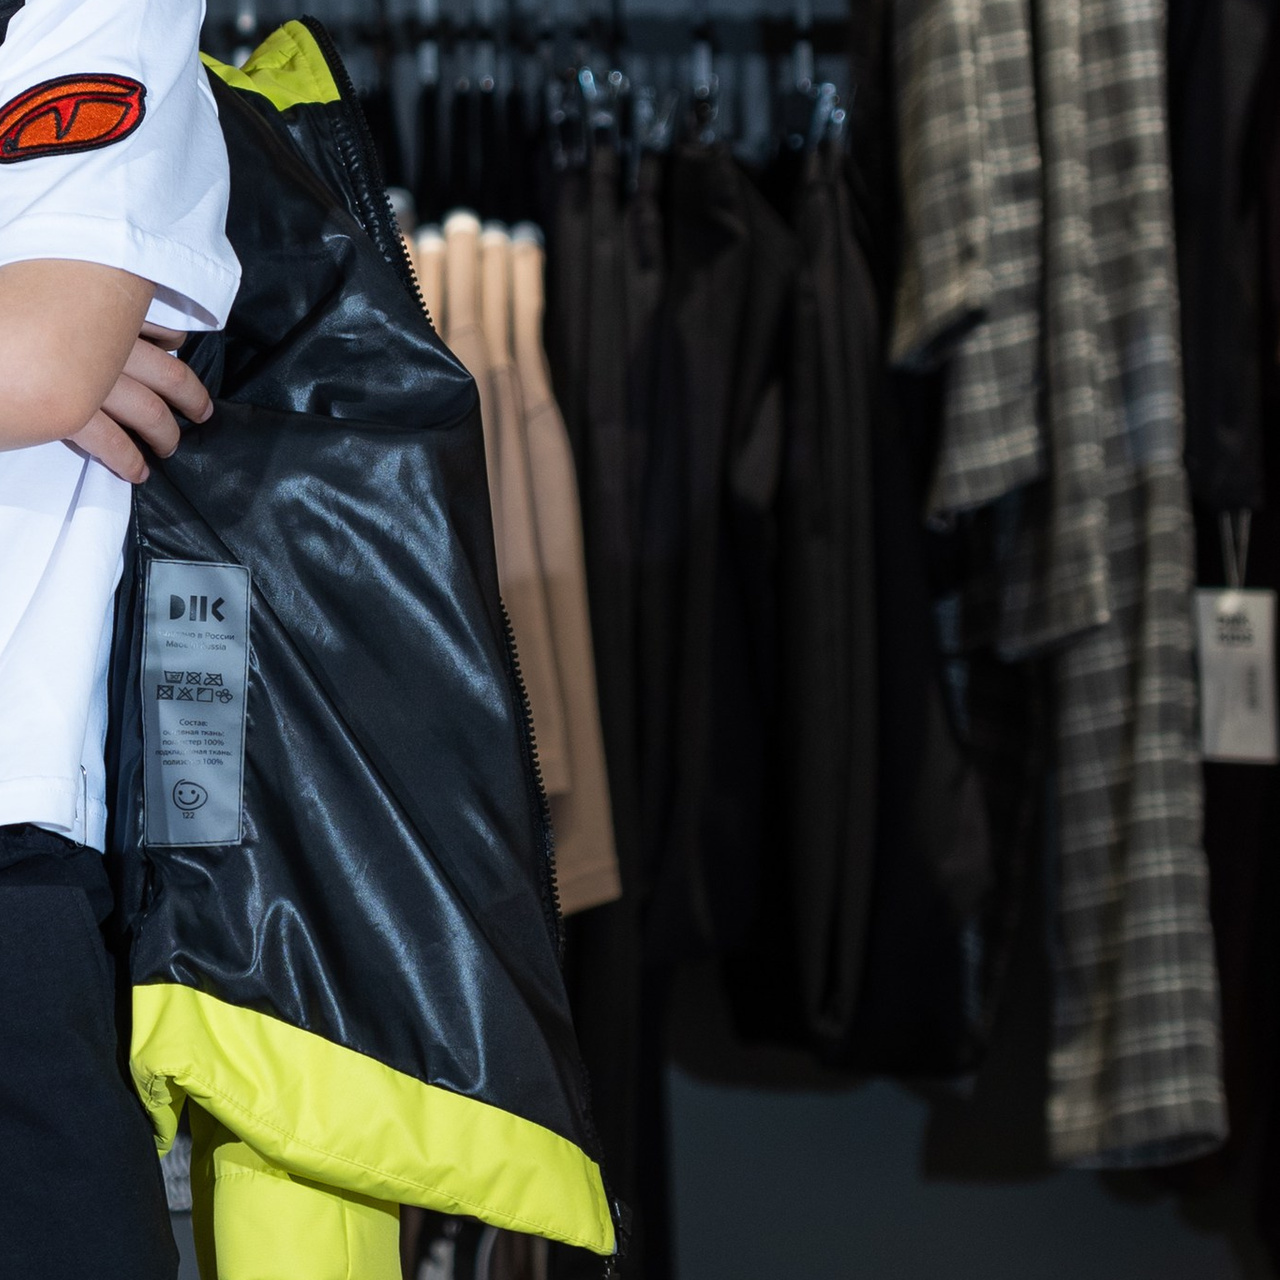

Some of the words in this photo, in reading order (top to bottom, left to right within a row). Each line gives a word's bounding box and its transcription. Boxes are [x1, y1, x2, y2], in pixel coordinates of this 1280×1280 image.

[179, 718, 208, 726] Состав:
[204, 739, 225, 747] 100%
[202, 758, 224, 766] 100%
[182, 811, 195, 819] 122
